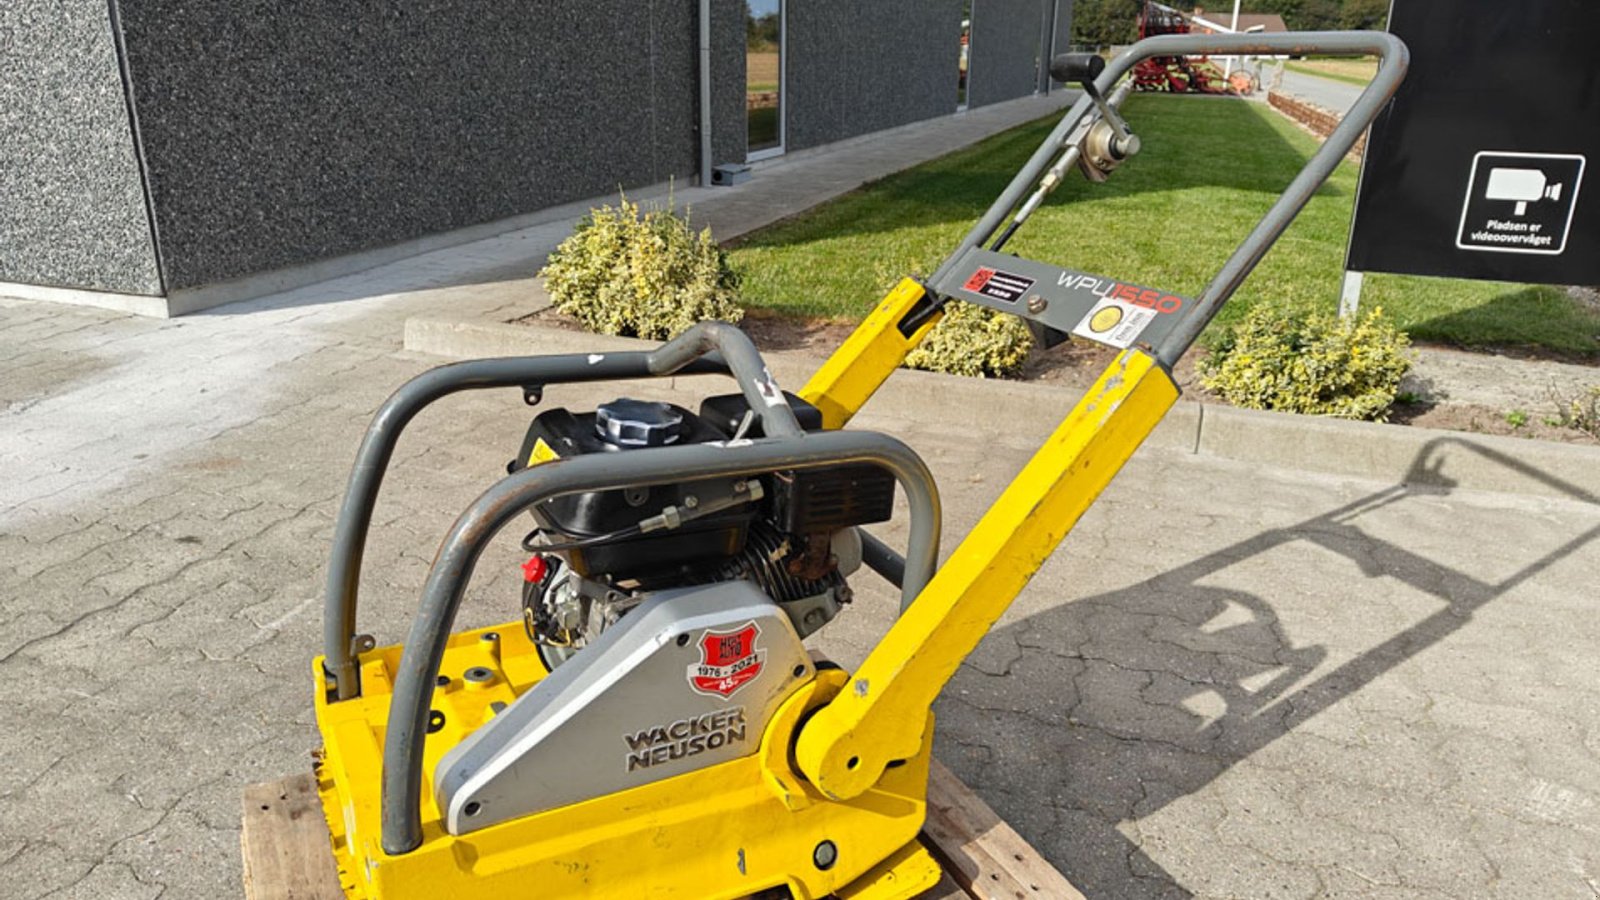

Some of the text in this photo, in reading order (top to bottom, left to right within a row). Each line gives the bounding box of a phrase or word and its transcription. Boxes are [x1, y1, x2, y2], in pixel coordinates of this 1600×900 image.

[1471, 231, 1552, 245] videoovervåget
[1487, 219, 1542, 232] Pladsen er
[1057, 271, 1182, 314] WPU1550
[698, 666, 721, 677] 1976
[731, 654, 758, 674] 2021
[624, 706, 746, 750] WACKER
[626, 723, 746, 773] NEUSON
